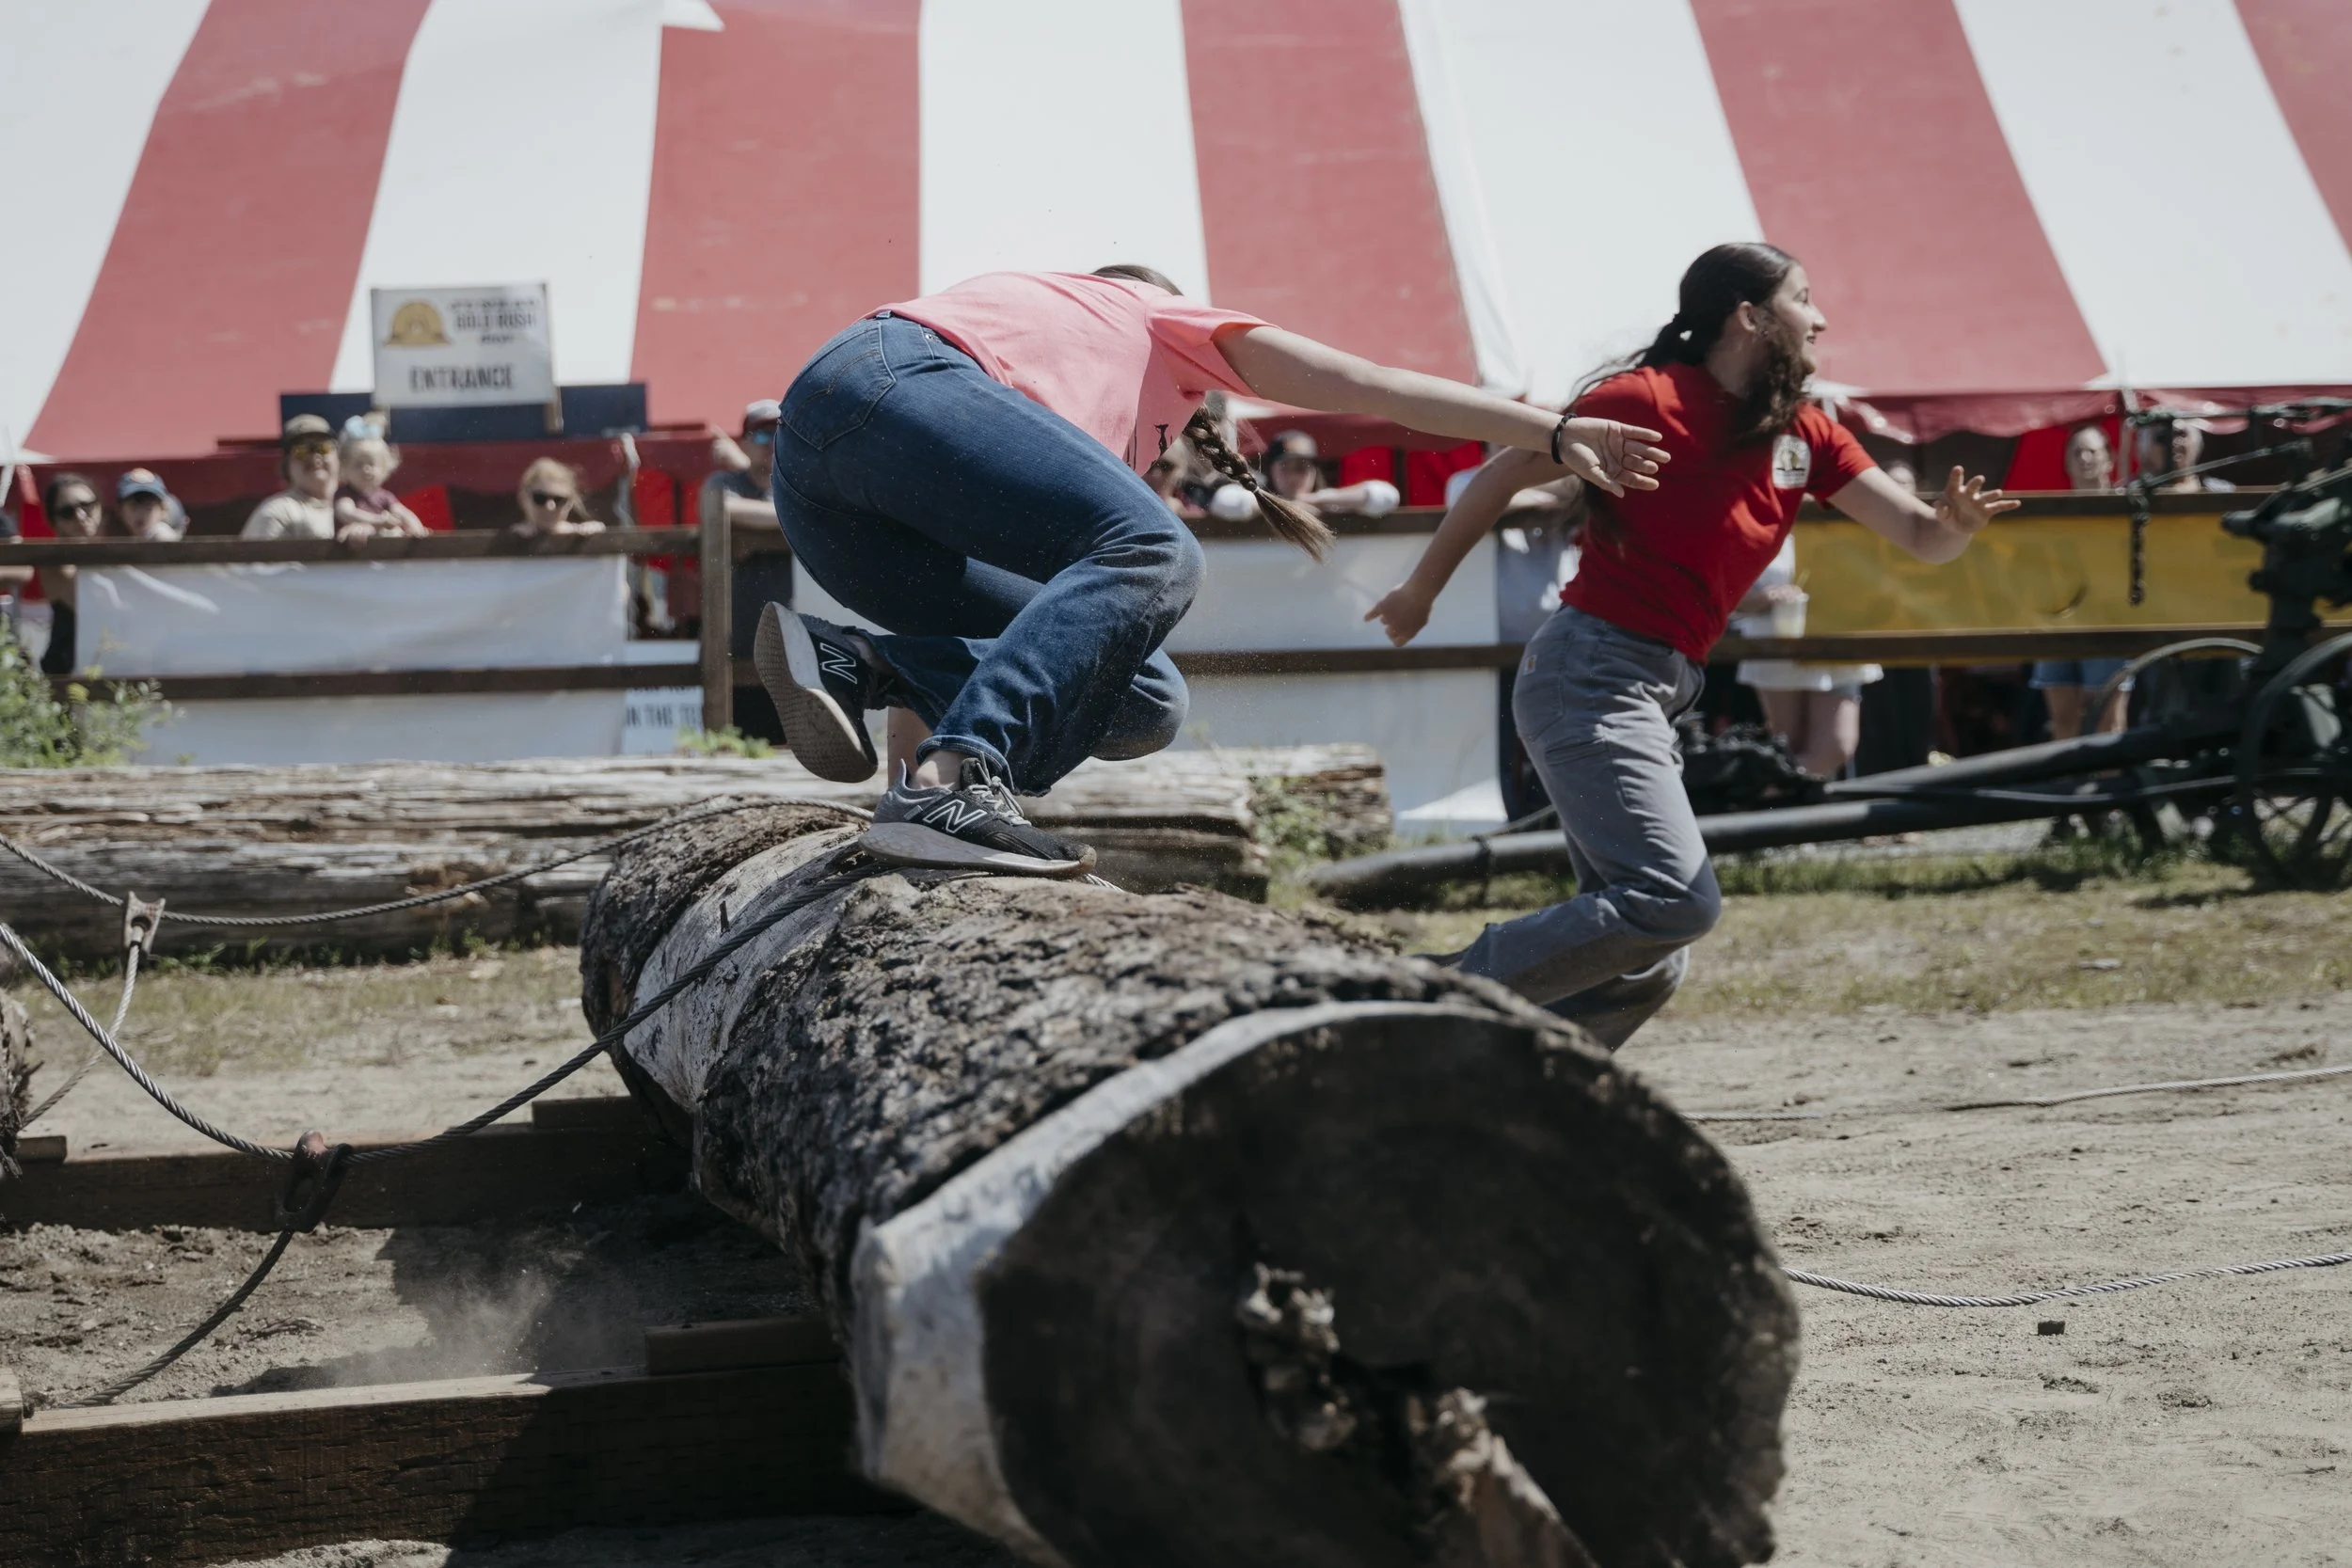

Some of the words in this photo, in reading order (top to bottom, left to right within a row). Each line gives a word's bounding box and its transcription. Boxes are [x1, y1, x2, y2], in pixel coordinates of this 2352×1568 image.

[408, 363, 515, 393] ENTRANCE
[819, 641, 858, 685] N
[923, 800, 988, 834] N
